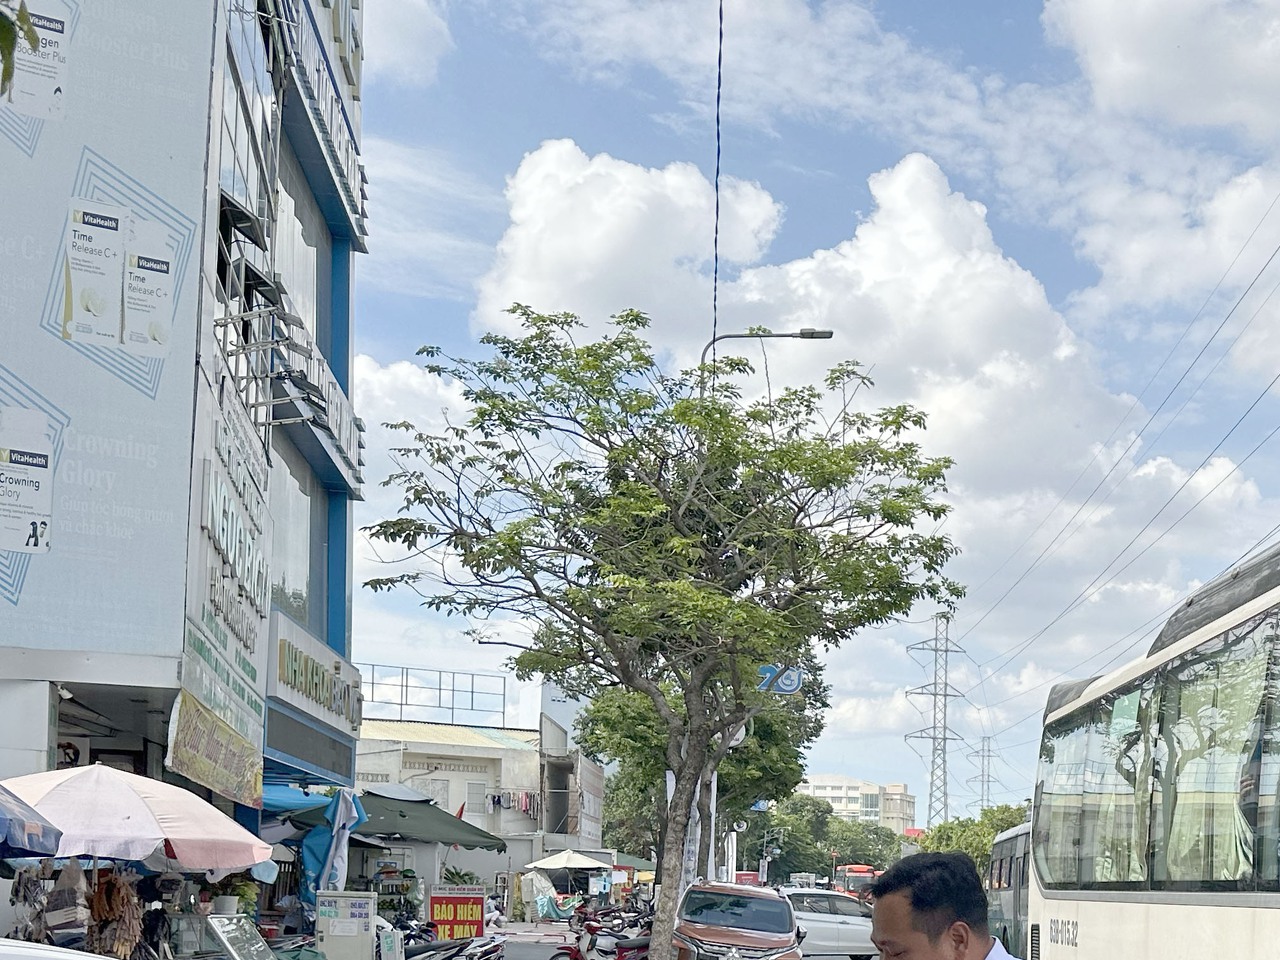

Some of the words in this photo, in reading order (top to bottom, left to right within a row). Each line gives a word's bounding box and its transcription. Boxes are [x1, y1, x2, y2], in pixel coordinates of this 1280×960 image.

[30, 15, 62, 30] VitaHealth
[84, 214, 118, 228] VitaHealth
[72, 229, 93, 243] Time
[71, 241, 103, 257] Release
[139, 258, 169, 271] VitaHealth
[128, 271, 146, 284] Time
[127, 282, 154, 297] Release
[11, 452, 46, 465] VitaHealth
[0, 472, 40, 491] Crowning
[279, 638, 304, 694] NHA
[304, 652, 331, 710] KHOA
[434, 900, 454, 920] BẢO
[457, 899, 481, 920] HIỂM
[437, 924, 450, 940] XE
[453, 922, 477, 939] MÁY
